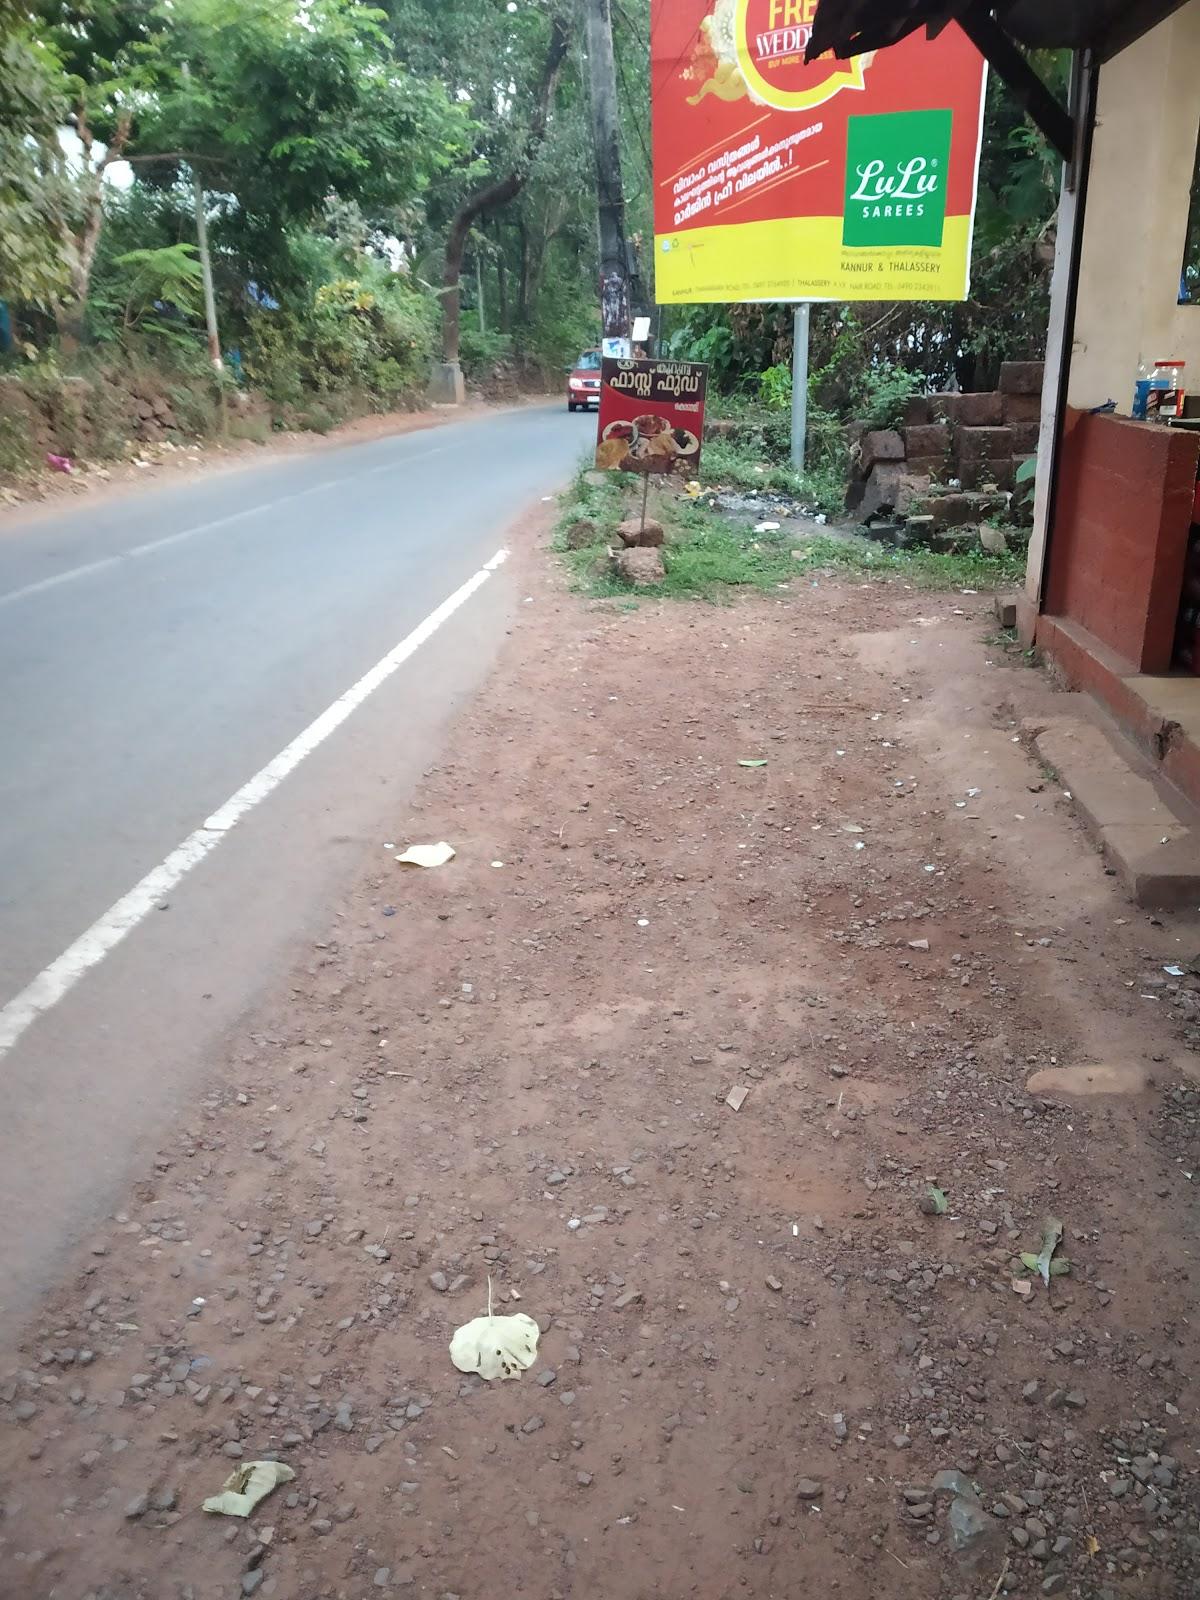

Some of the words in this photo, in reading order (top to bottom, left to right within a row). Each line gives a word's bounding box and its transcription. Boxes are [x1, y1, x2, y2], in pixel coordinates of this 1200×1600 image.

[769, 0, 820, 30] FRE
[673, 167, 705, 195] വിവാഹ
[850, 156, 938, 201] LuLu
[862, 203, 924, 218] SAREES
[840, 261, 873, 272] KANNUR
[878, 262, 884, 272] &
[889, 261, 940, 273] THALASSERY
[657, 370, 703, 397] ഫുഡ്
